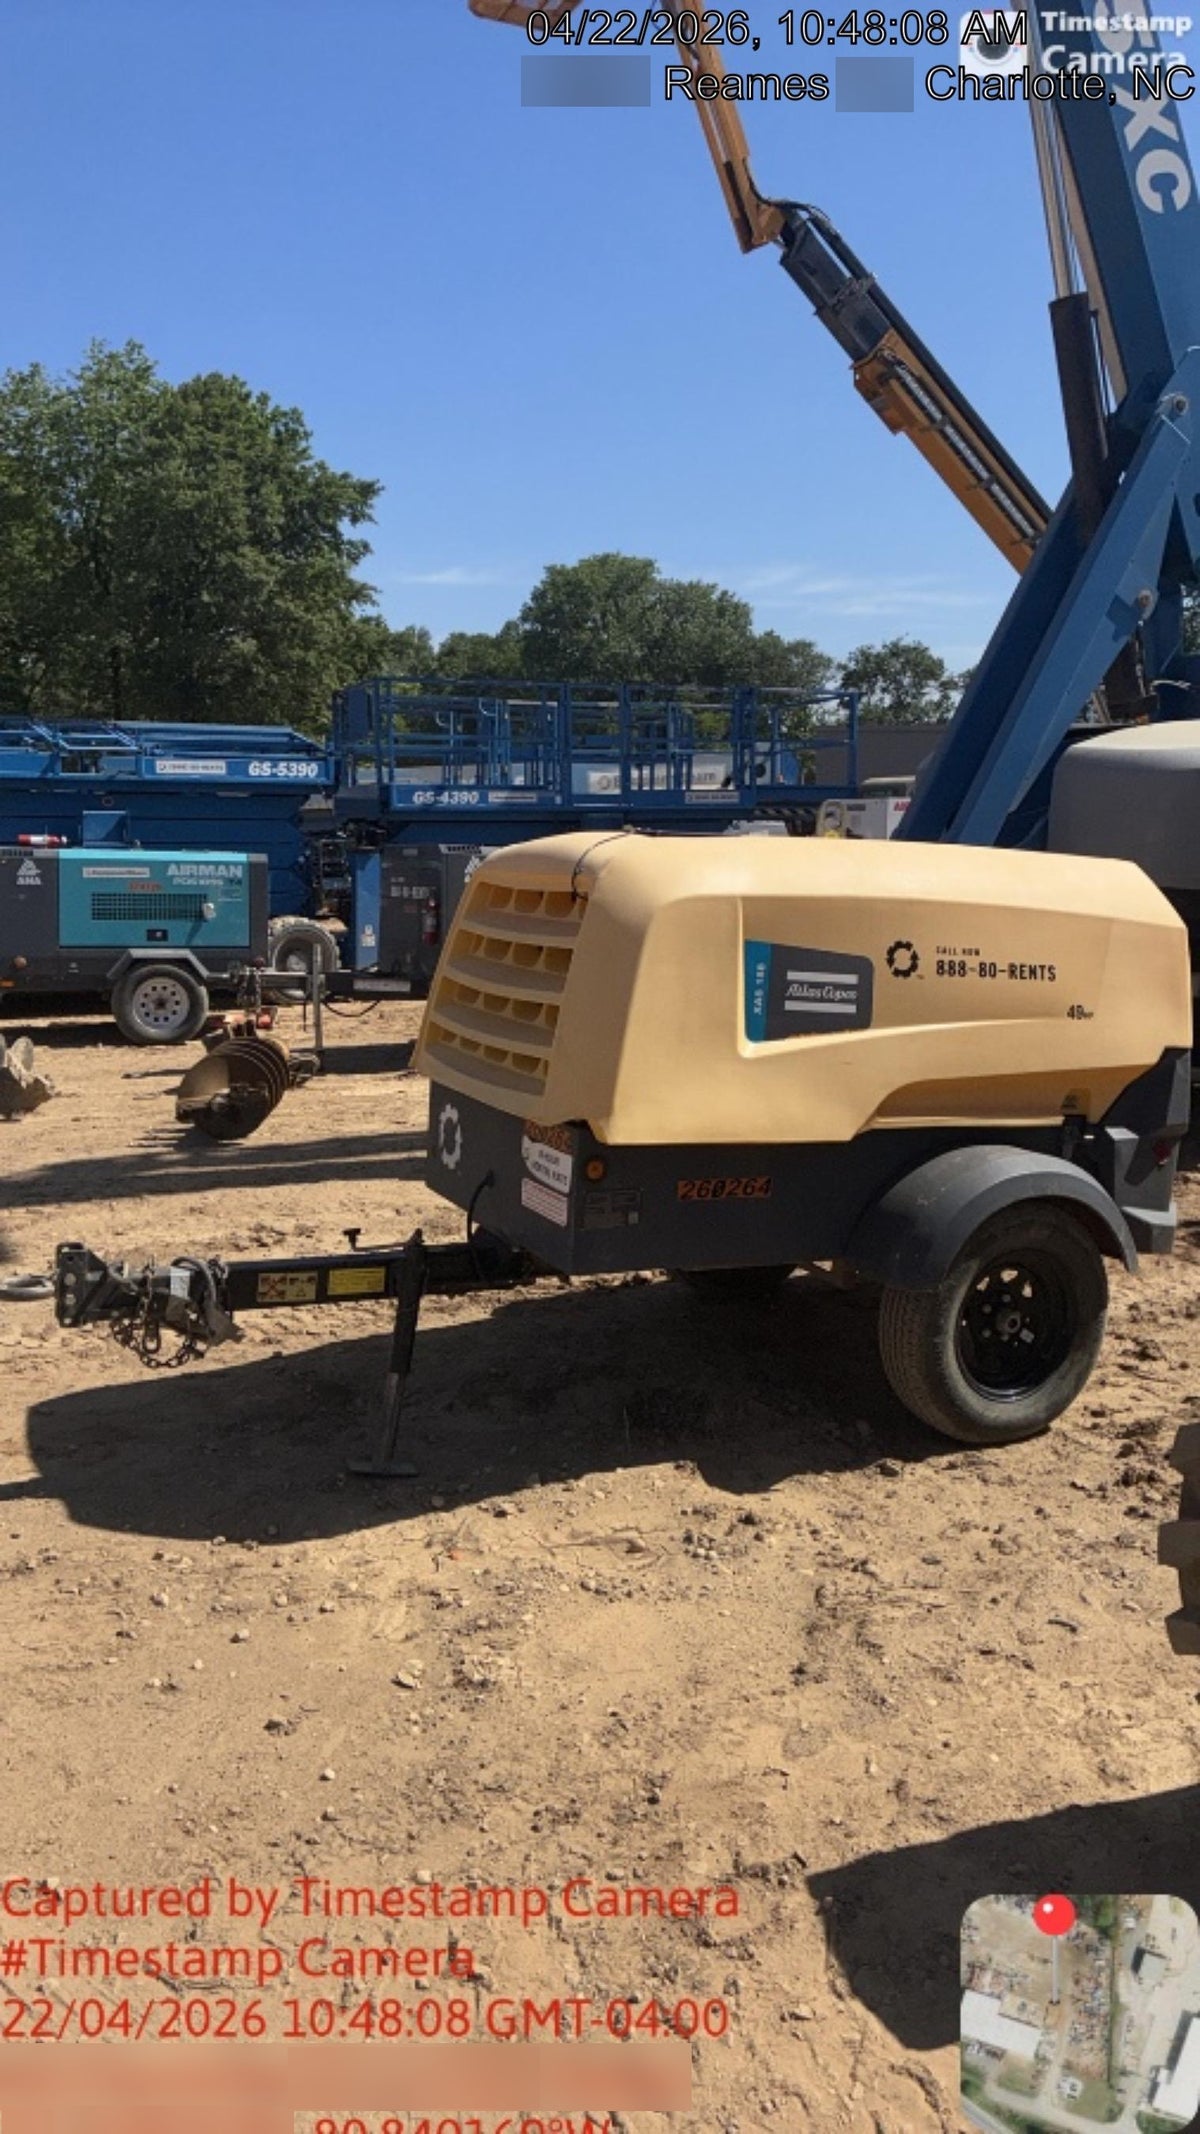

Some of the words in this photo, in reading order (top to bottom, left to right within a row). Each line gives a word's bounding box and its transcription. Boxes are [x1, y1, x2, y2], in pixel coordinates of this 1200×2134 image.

[248, 761, 318, 778] GS-5390
[412, 791, 479, 804] GS-4390
[167, 863, 243, 878] AIRMAN
[936, 959, 1056, 982] 888-80-RENTS
[785, 983, 821, 998] Atlas
[822, 985, 857, 1001] Copco
[680, 1178, 772, 1200] 260264
